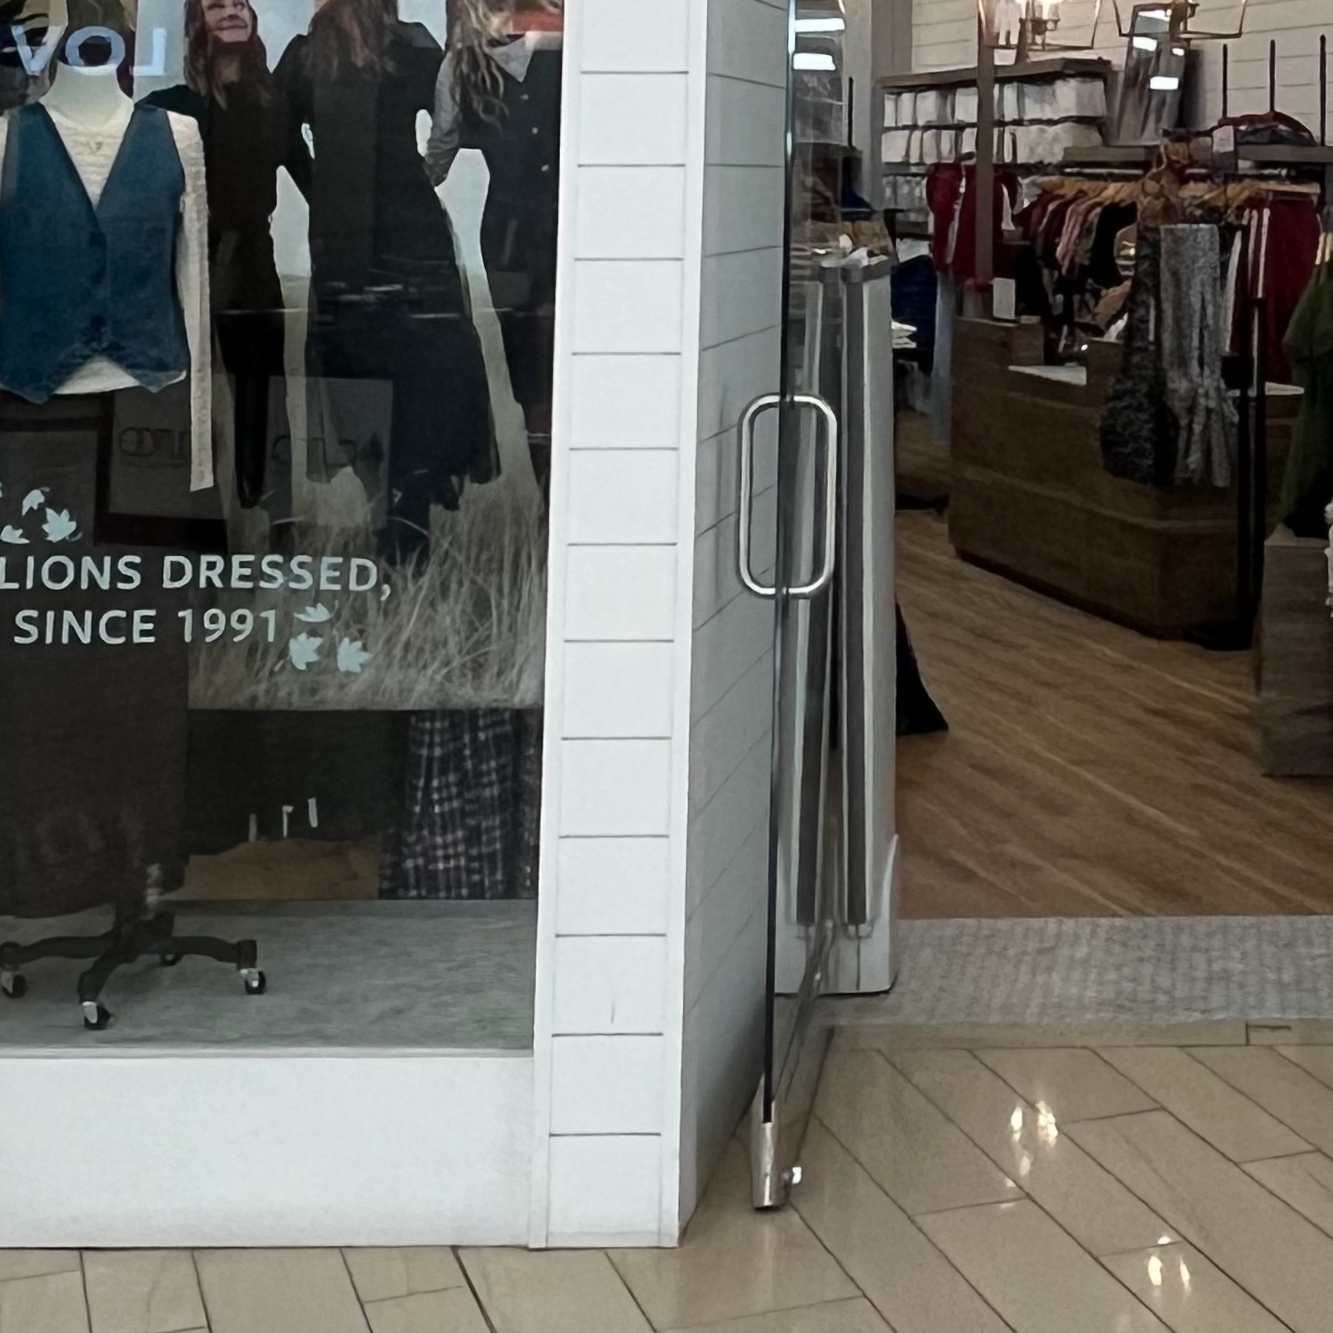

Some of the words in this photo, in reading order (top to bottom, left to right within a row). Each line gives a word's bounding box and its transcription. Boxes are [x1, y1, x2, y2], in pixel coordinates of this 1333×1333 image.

[162, 554, 391, 601] DRESSED,
[13, 609, 157, 644] SINCE
[177, 608, 278, 644] 1991
